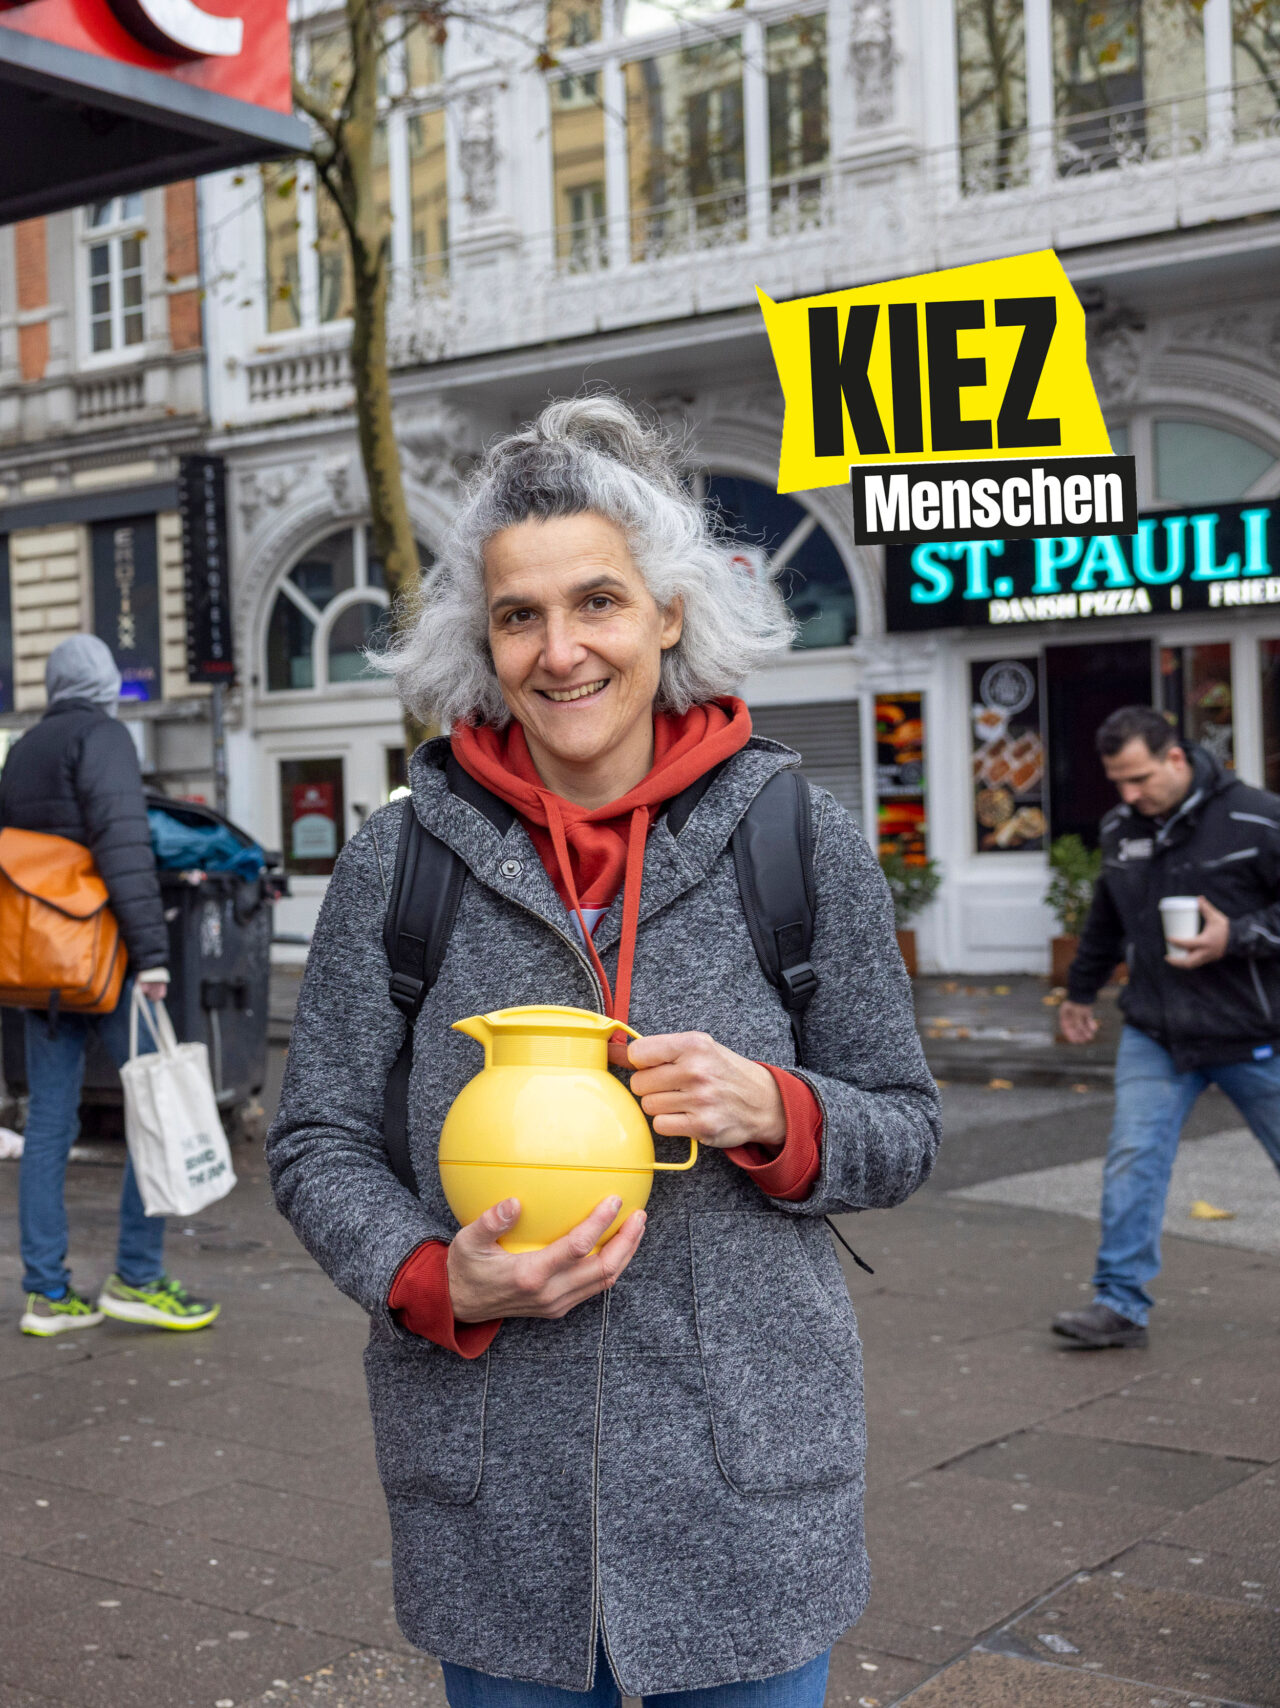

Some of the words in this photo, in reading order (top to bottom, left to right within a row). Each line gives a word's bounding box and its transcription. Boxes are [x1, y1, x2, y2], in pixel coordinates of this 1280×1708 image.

[910, 540, 1014, 604] ST.
[1032, 508, 1272, 595] PAULI
[988, 593, 1077, 624] DANISH
[1079, 587, 1152, 617] PIZZA
